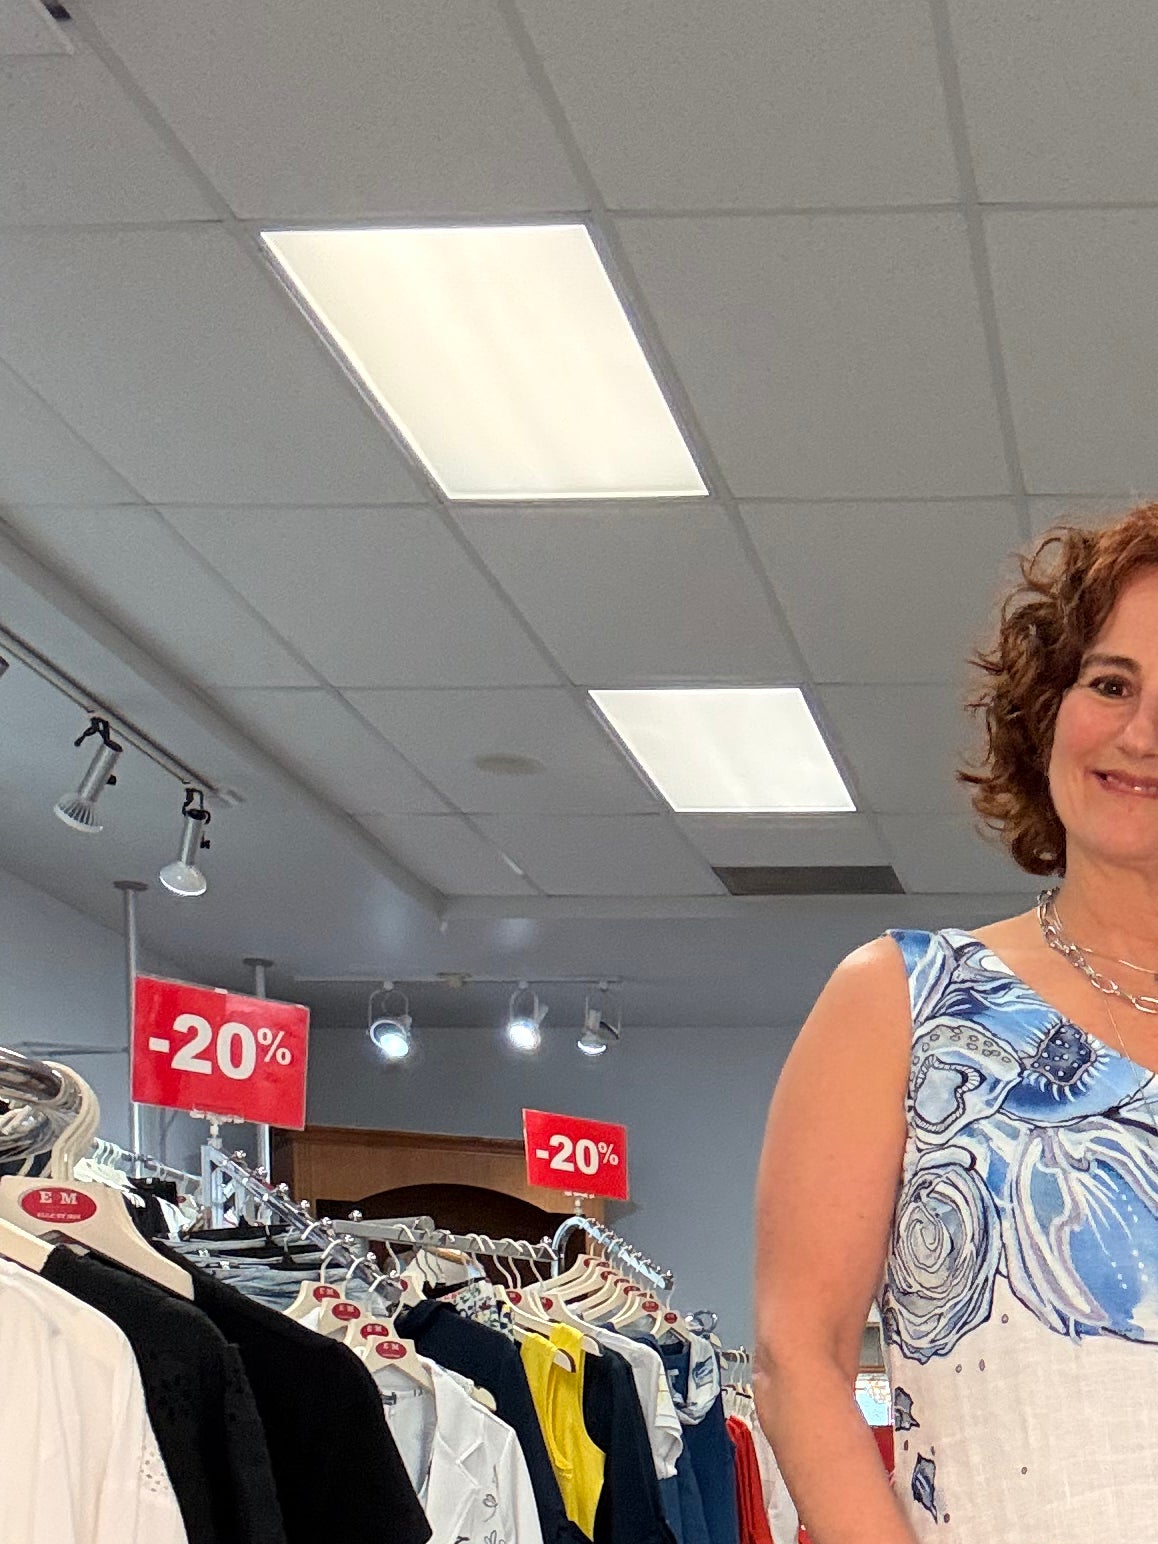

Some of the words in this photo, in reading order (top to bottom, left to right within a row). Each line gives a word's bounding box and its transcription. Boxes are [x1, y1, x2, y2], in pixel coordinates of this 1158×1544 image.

[149, 1013, 292, 1080] -20%
[535, 1134, 619, 1175] -20%
[39, 1191, 52, 1203] E
[60, 1192, 78, 1204] M
